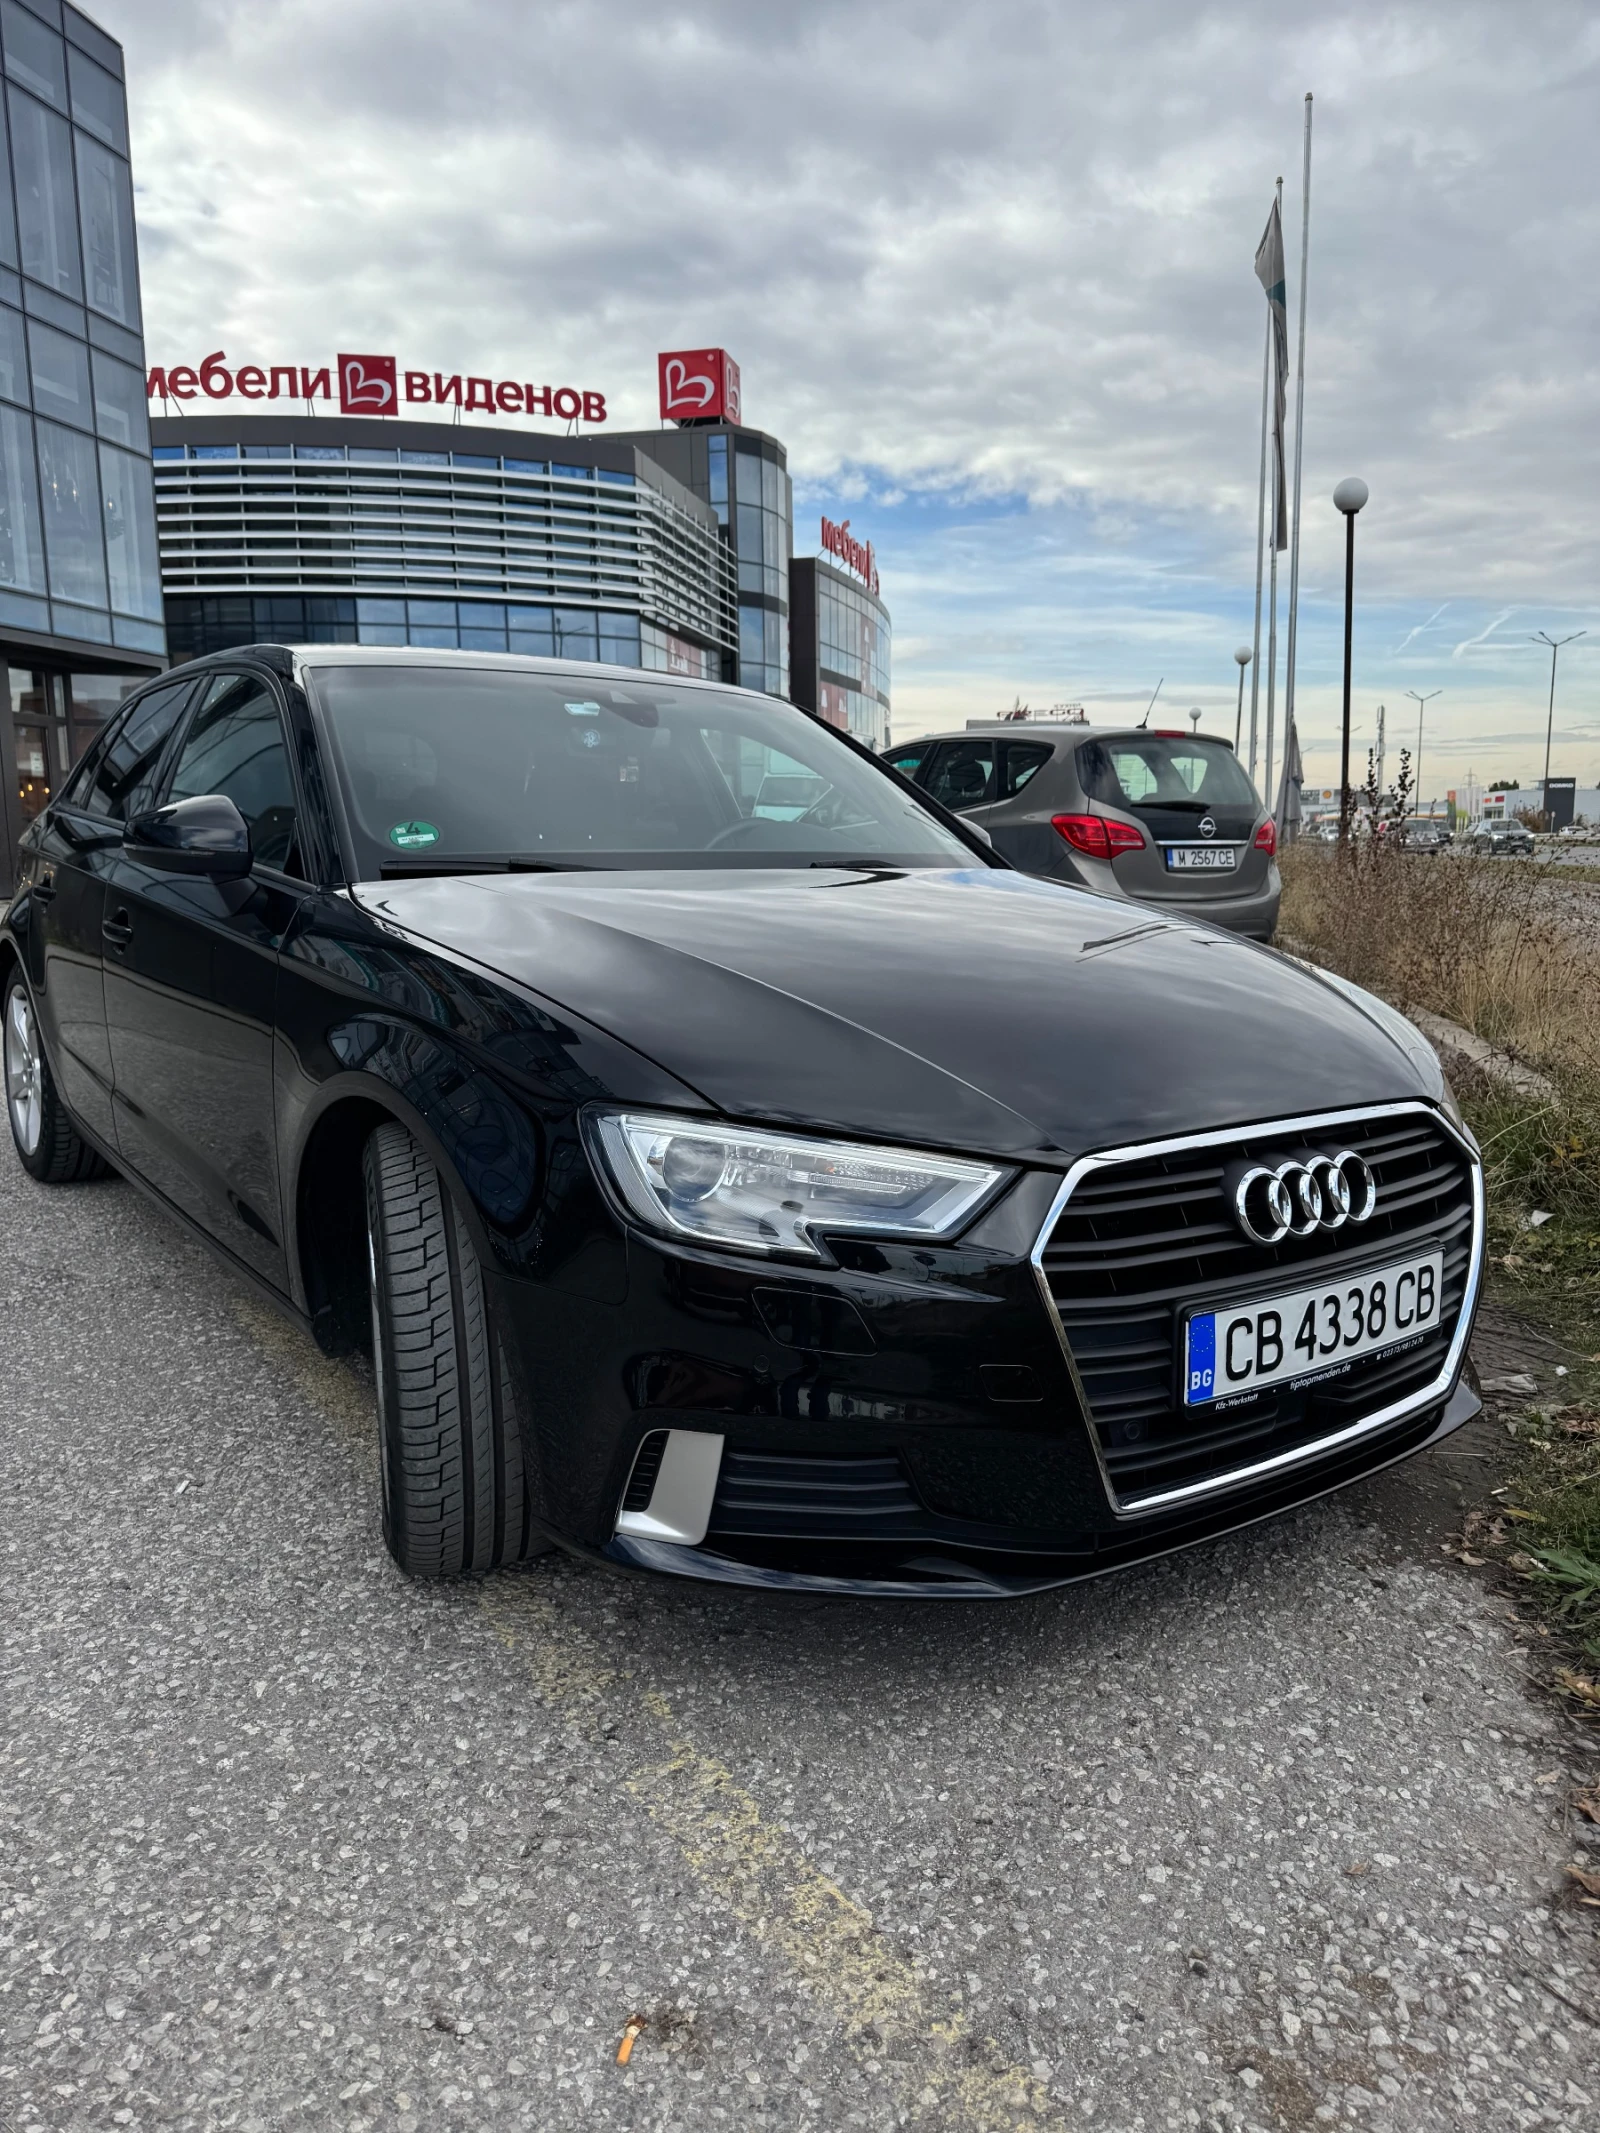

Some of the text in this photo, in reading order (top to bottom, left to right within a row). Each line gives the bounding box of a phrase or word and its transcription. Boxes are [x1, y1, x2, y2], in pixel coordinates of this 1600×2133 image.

[404, 371, 608, 423] виденов
[1178, 851, 1233, 865] M 2567 CE
[1225, 1264, 1435, 1381] CB 4338 CB
[1190, 1368, 1213, 1391] BG
